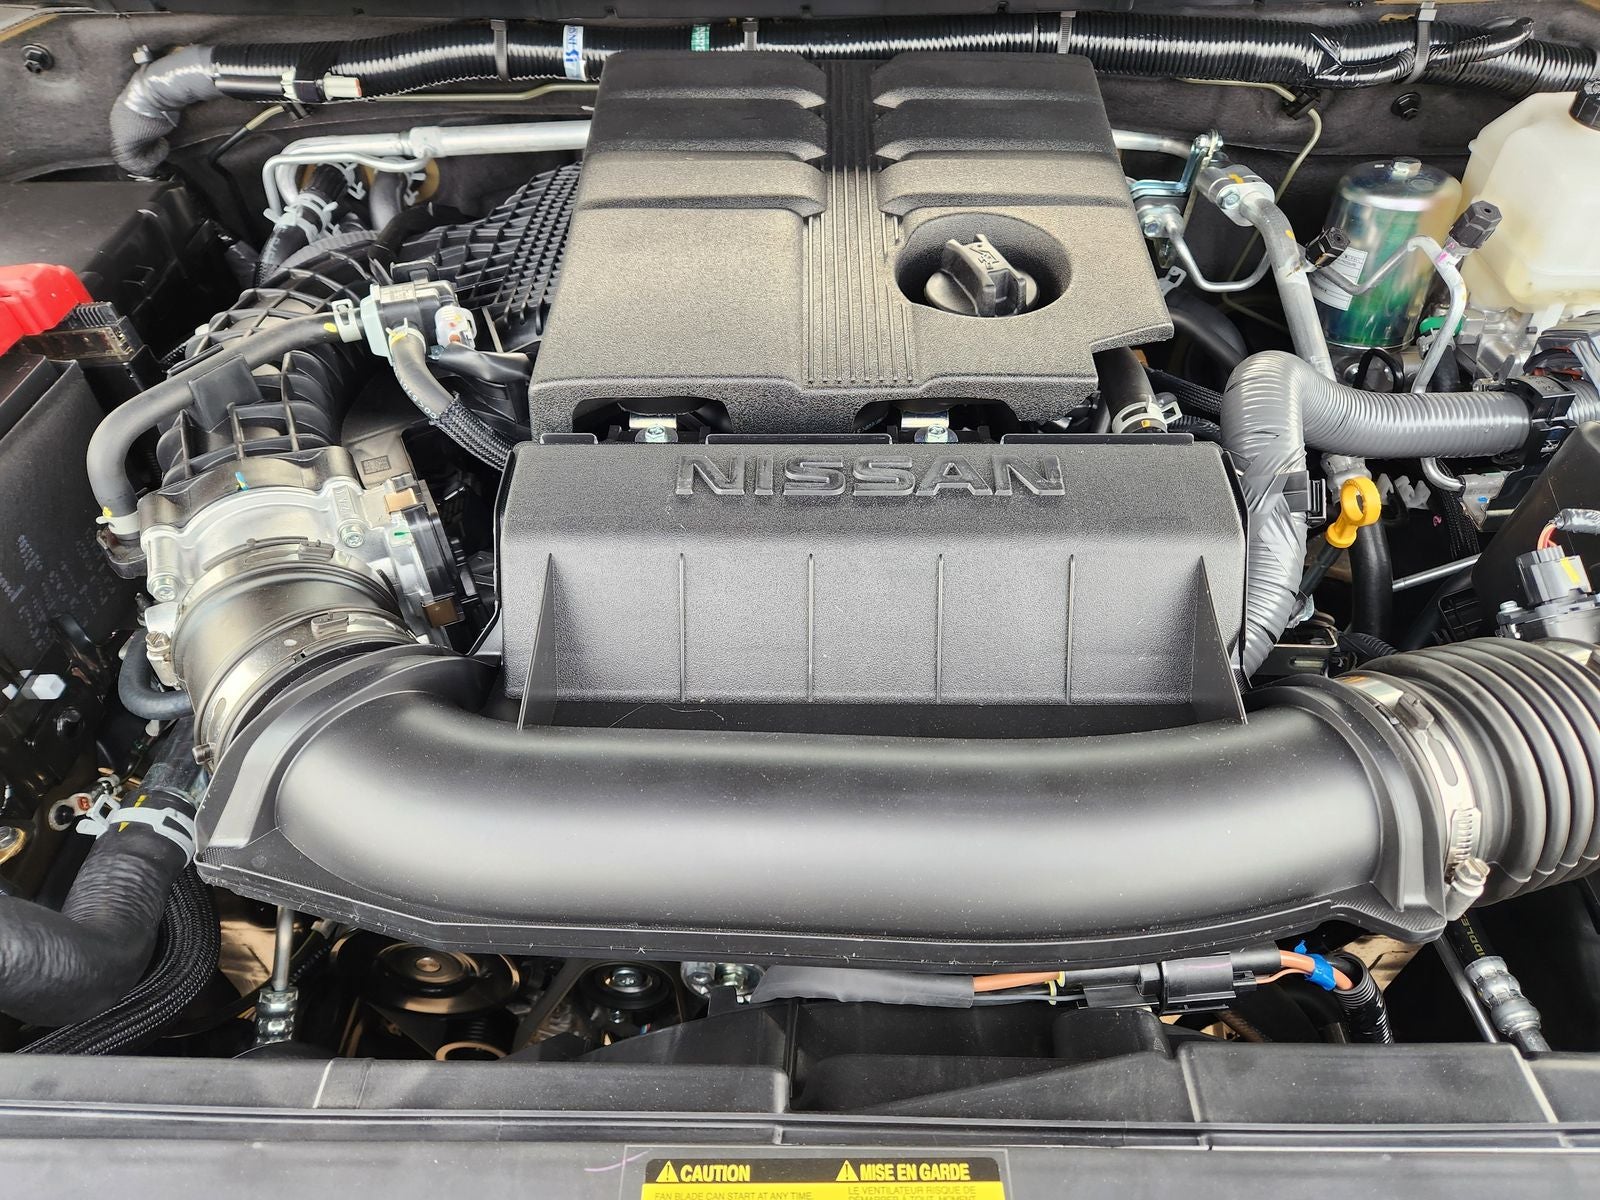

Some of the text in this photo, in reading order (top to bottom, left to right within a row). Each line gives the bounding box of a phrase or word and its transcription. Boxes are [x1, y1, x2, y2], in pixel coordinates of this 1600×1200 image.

[676, 455, 1065, 496] NISSAN
[680, 1164, 751, 1182] CAUTION
[860, 1163, 971, 1181] MISE EN GARDE
[655, 1192, 672, 1200] FAN
[675, 1192, 703, 1200] BLADE
[706, 1192, 725, 1200] CAN
[728, 1192, 755, 1200] START
[757, 1192, 768, 1200] AT
[770, 1192, 789, 1200] ANY
[848, 1186, 976, 1195] LE VENTILATEUR RISQUE DE
